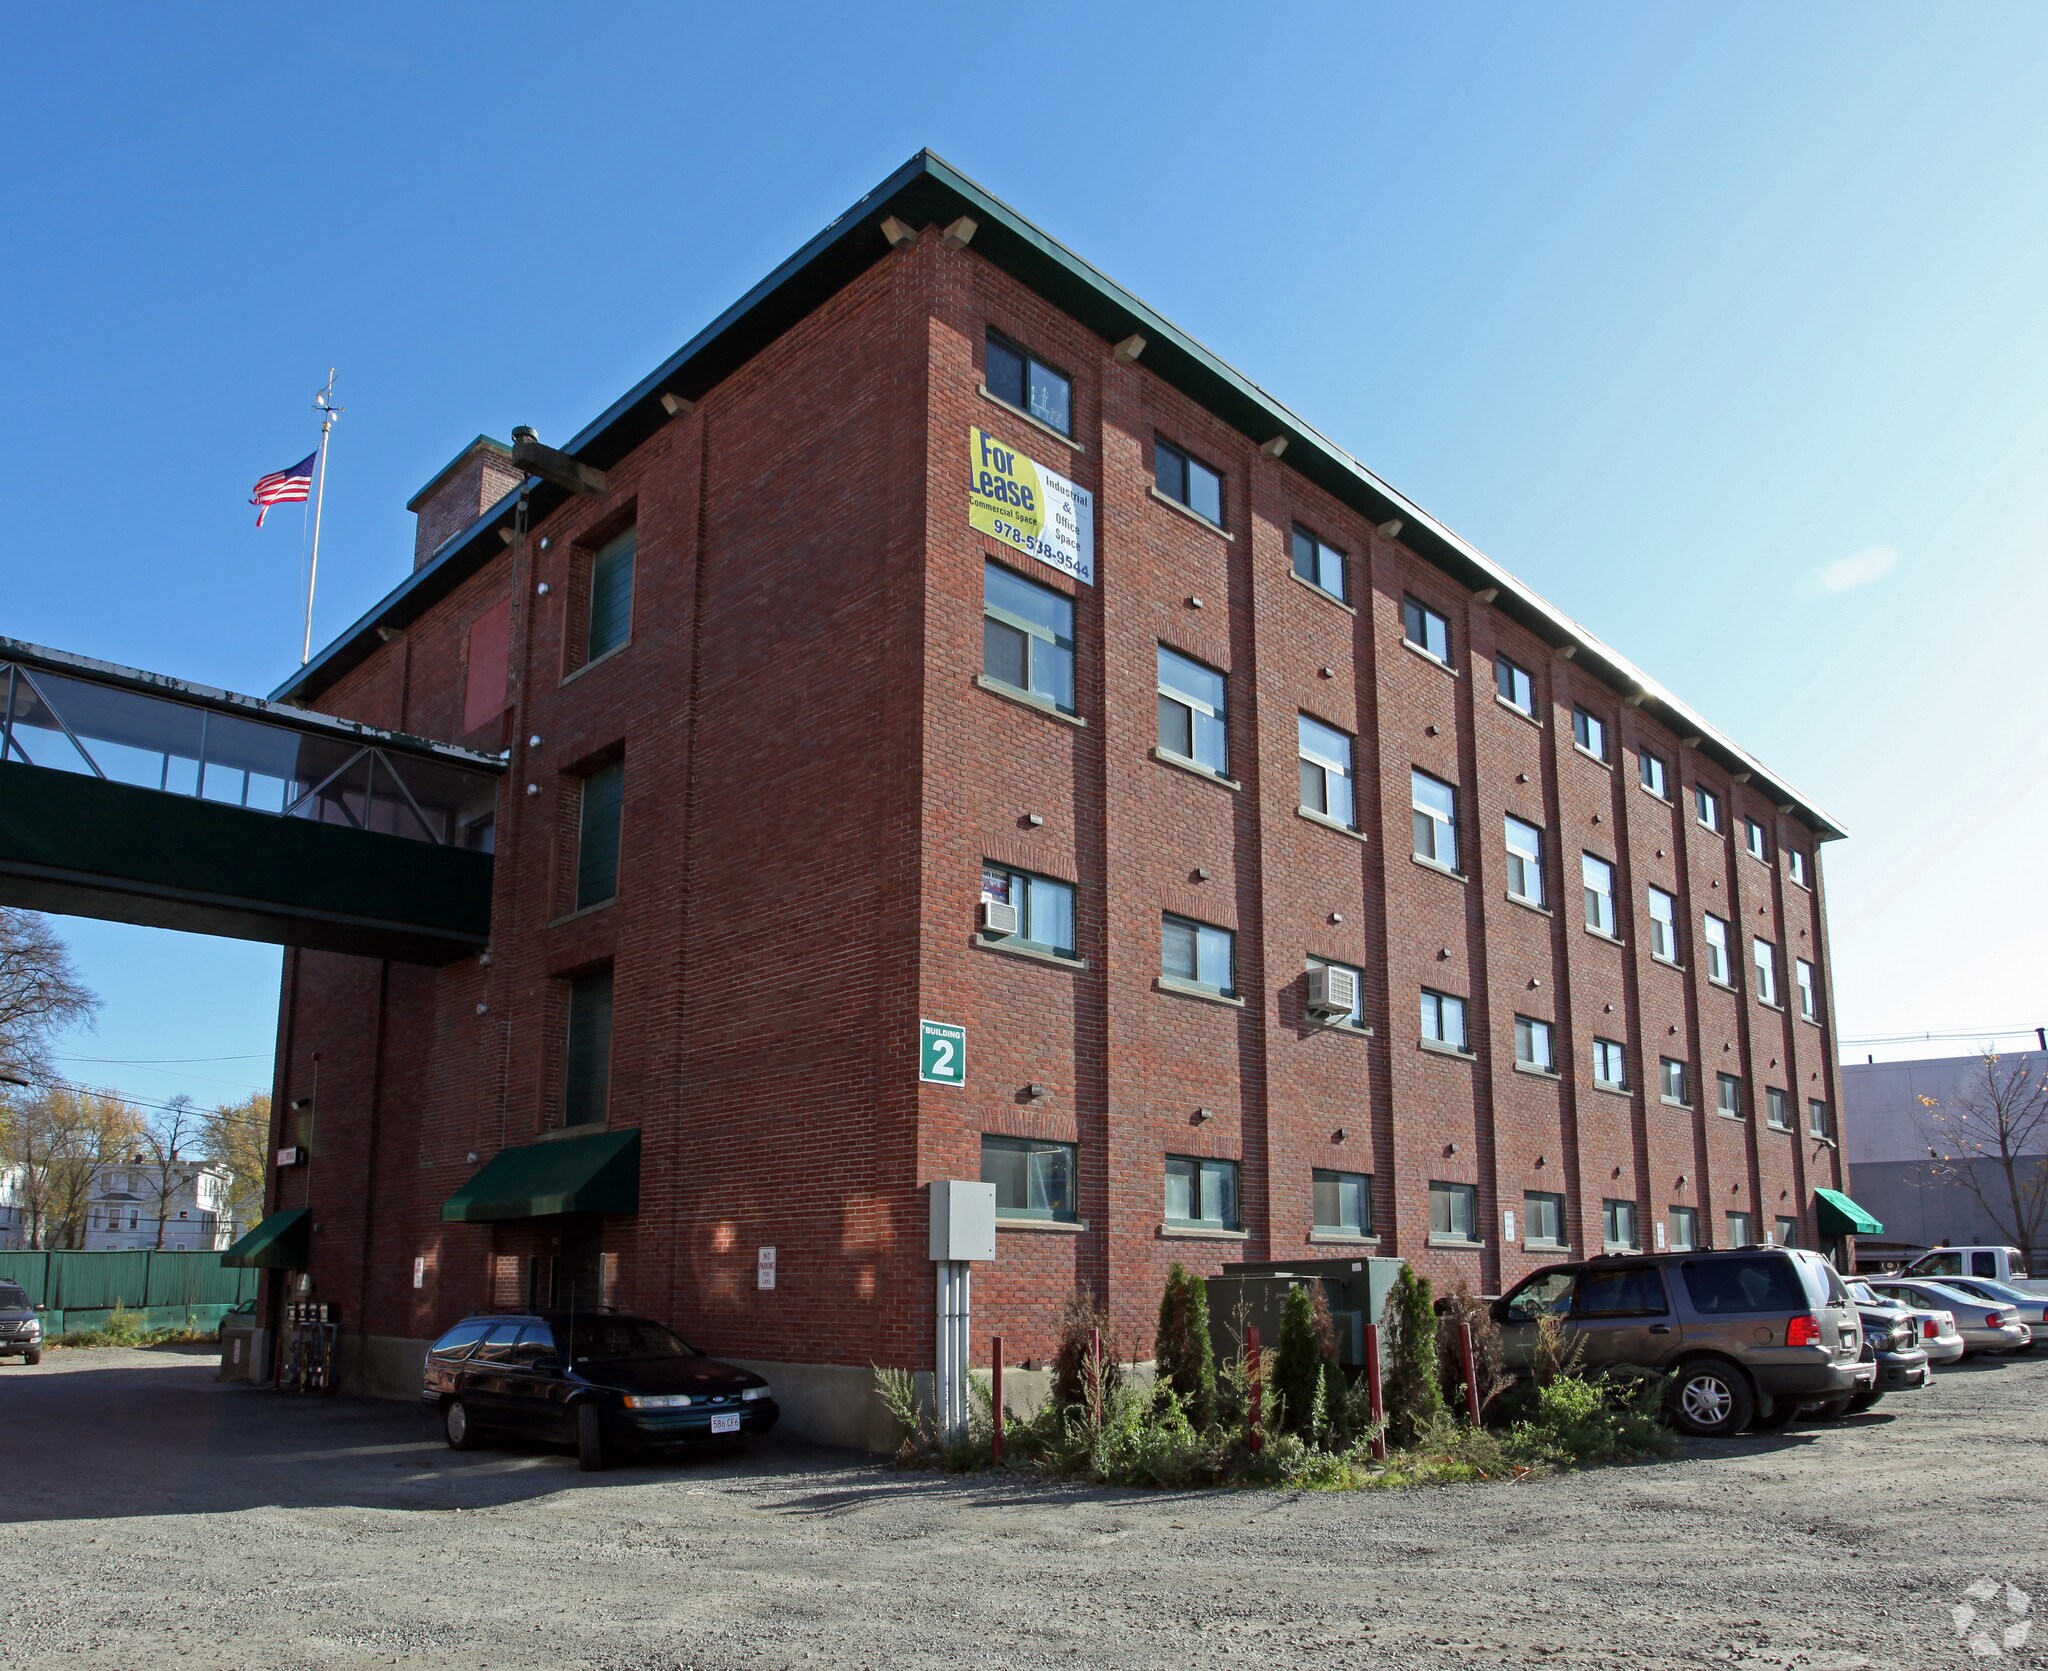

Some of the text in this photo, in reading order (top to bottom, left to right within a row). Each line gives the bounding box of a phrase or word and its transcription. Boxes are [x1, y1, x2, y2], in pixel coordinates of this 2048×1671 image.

[980, 431, 1014, 476] For
[969, 458, 1035, 511] Lease
[1046, 475, 1088, 507] Industrial
[970, 496, 1038, 526] Commercial Space
[1062, 502, 1072, 514] &
[1055, 513, 1080, 535] Office
[994, 519, 1090, 578] 978-538-9544
[1055, 529, 1081, 551] Space
[925, 1026, 961, 1039] BUILDING
[932, 1039, 954, 1077] 2
[713, 1419, 726, 1429] 586
